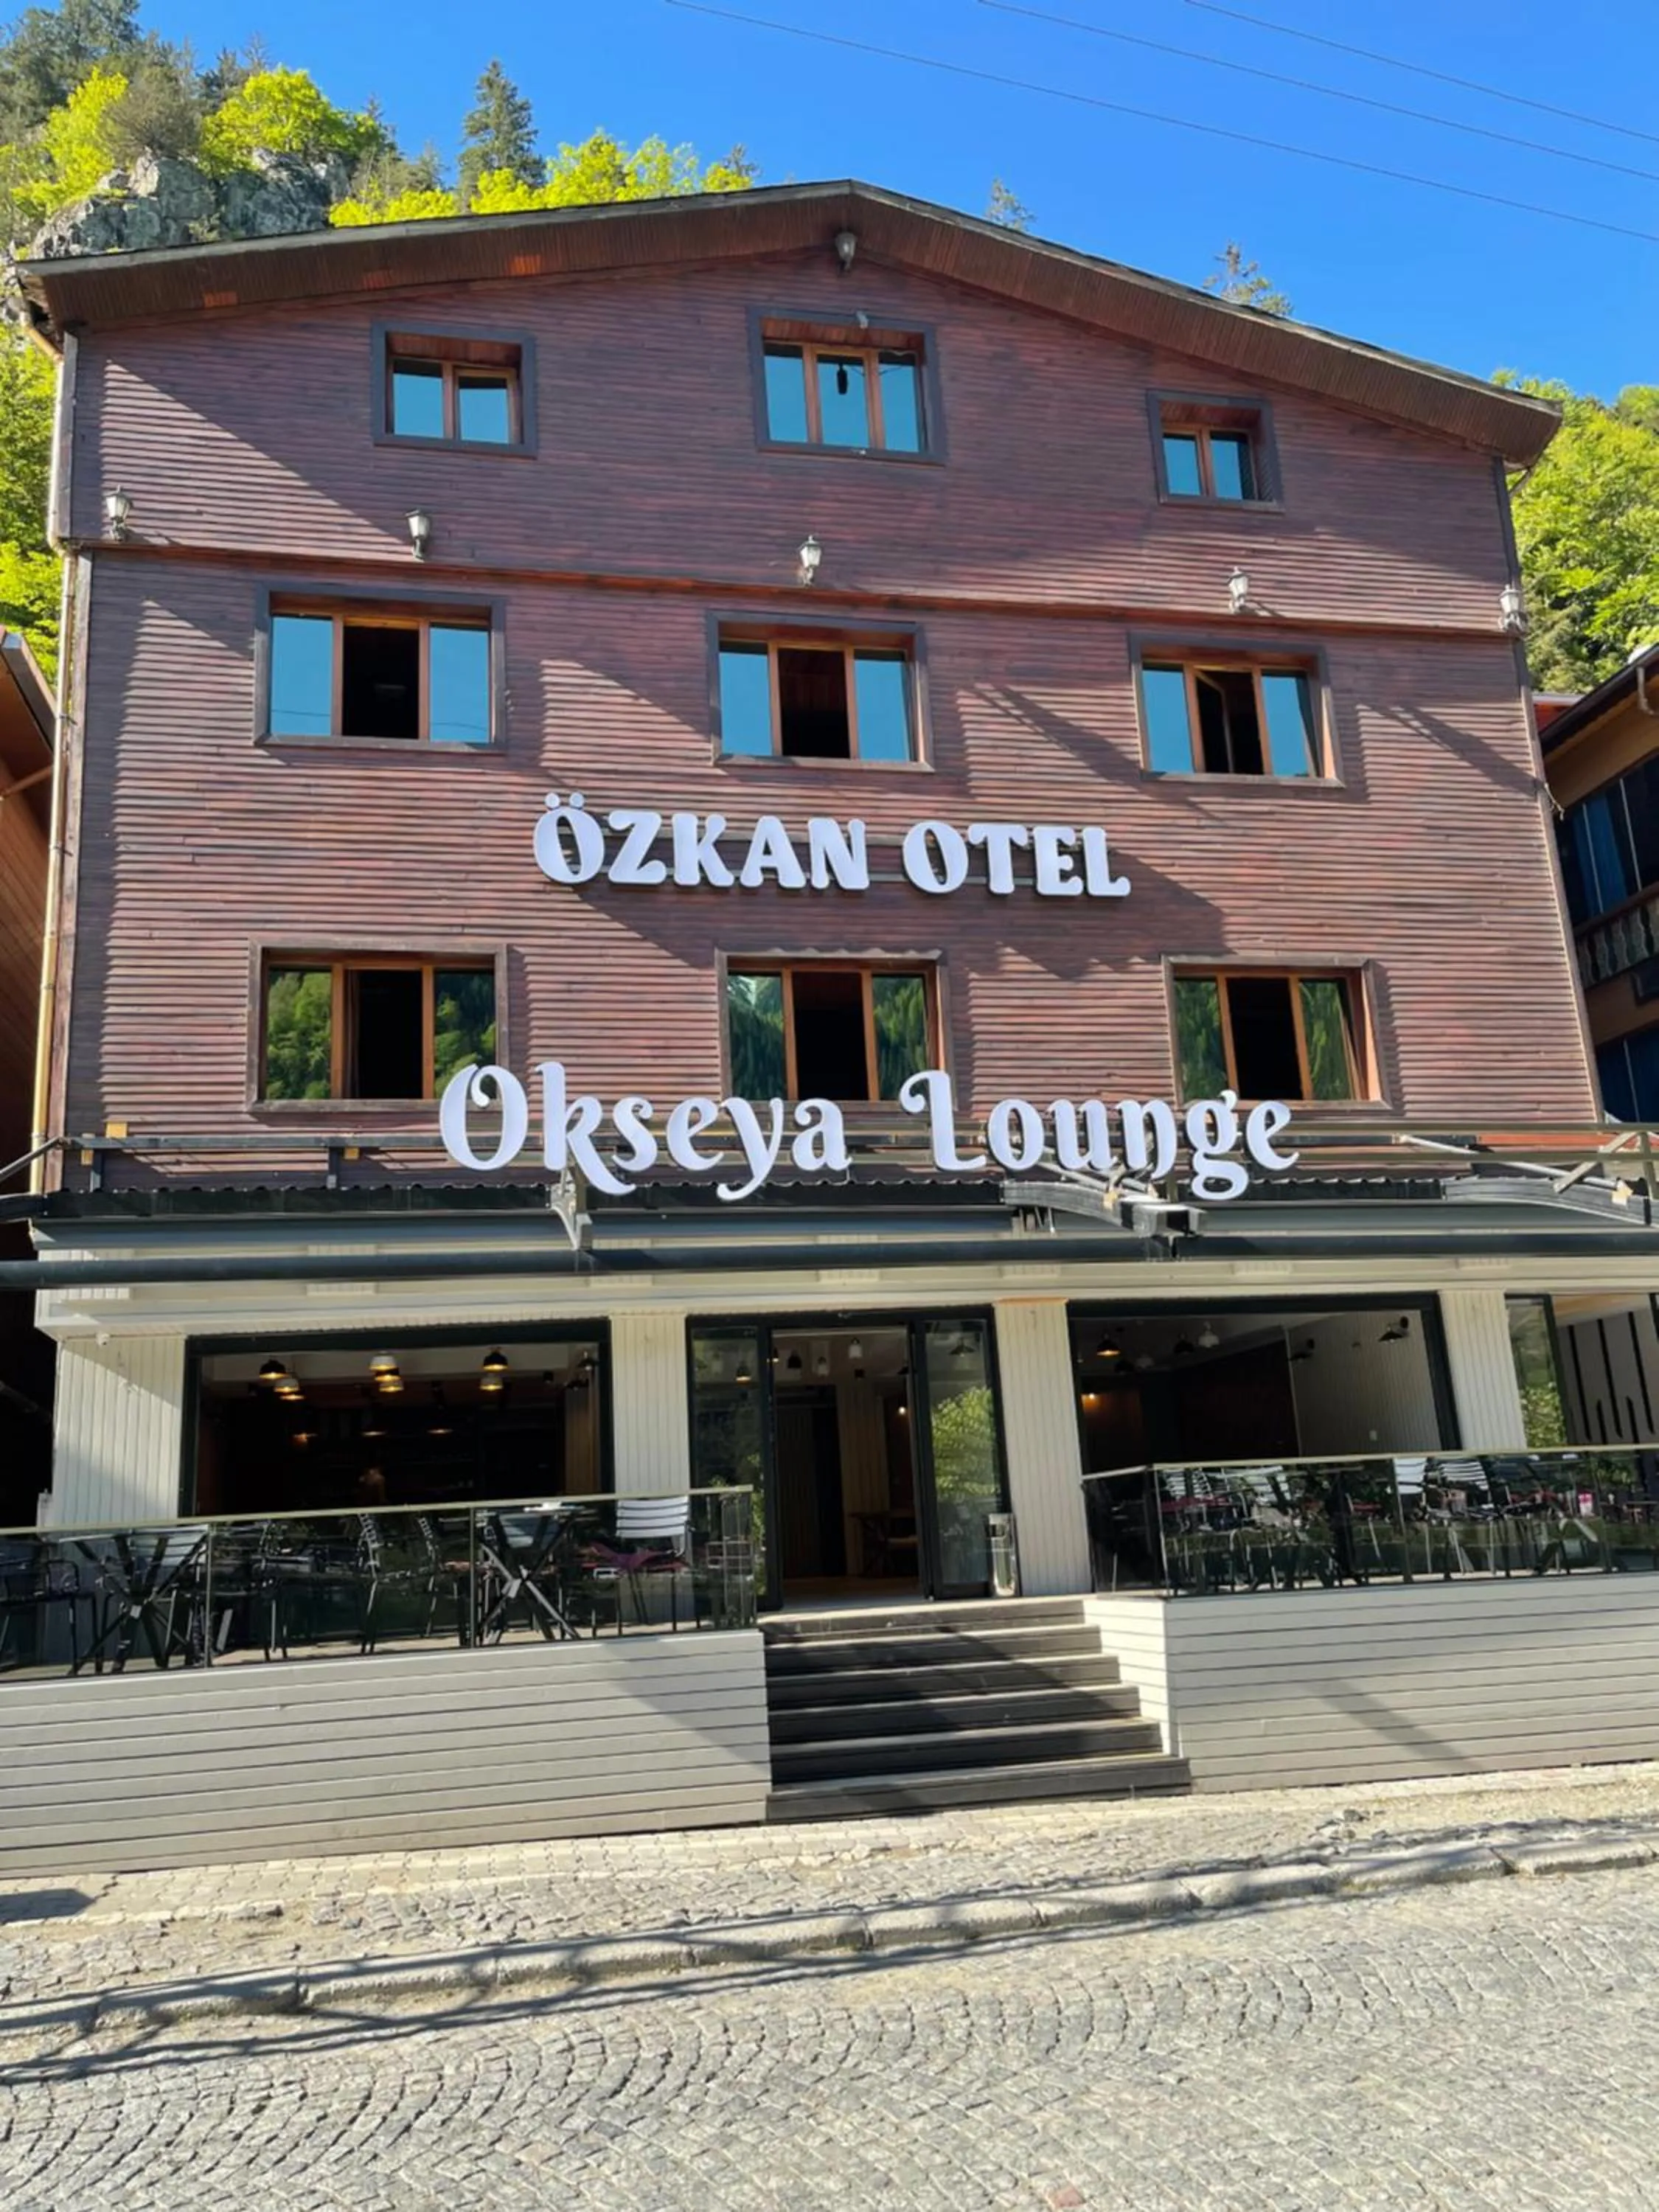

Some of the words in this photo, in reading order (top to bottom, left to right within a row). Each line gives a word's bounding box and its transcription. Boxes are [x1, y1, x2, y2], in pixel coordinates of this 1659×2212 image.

[532, 792, 870, 891] ÖZKAN
[902, 820, 1132, 898] OTEL
[439, 1060, 853, 1202] Okseya
[899, 1069, 1301, 1201] Lounge
